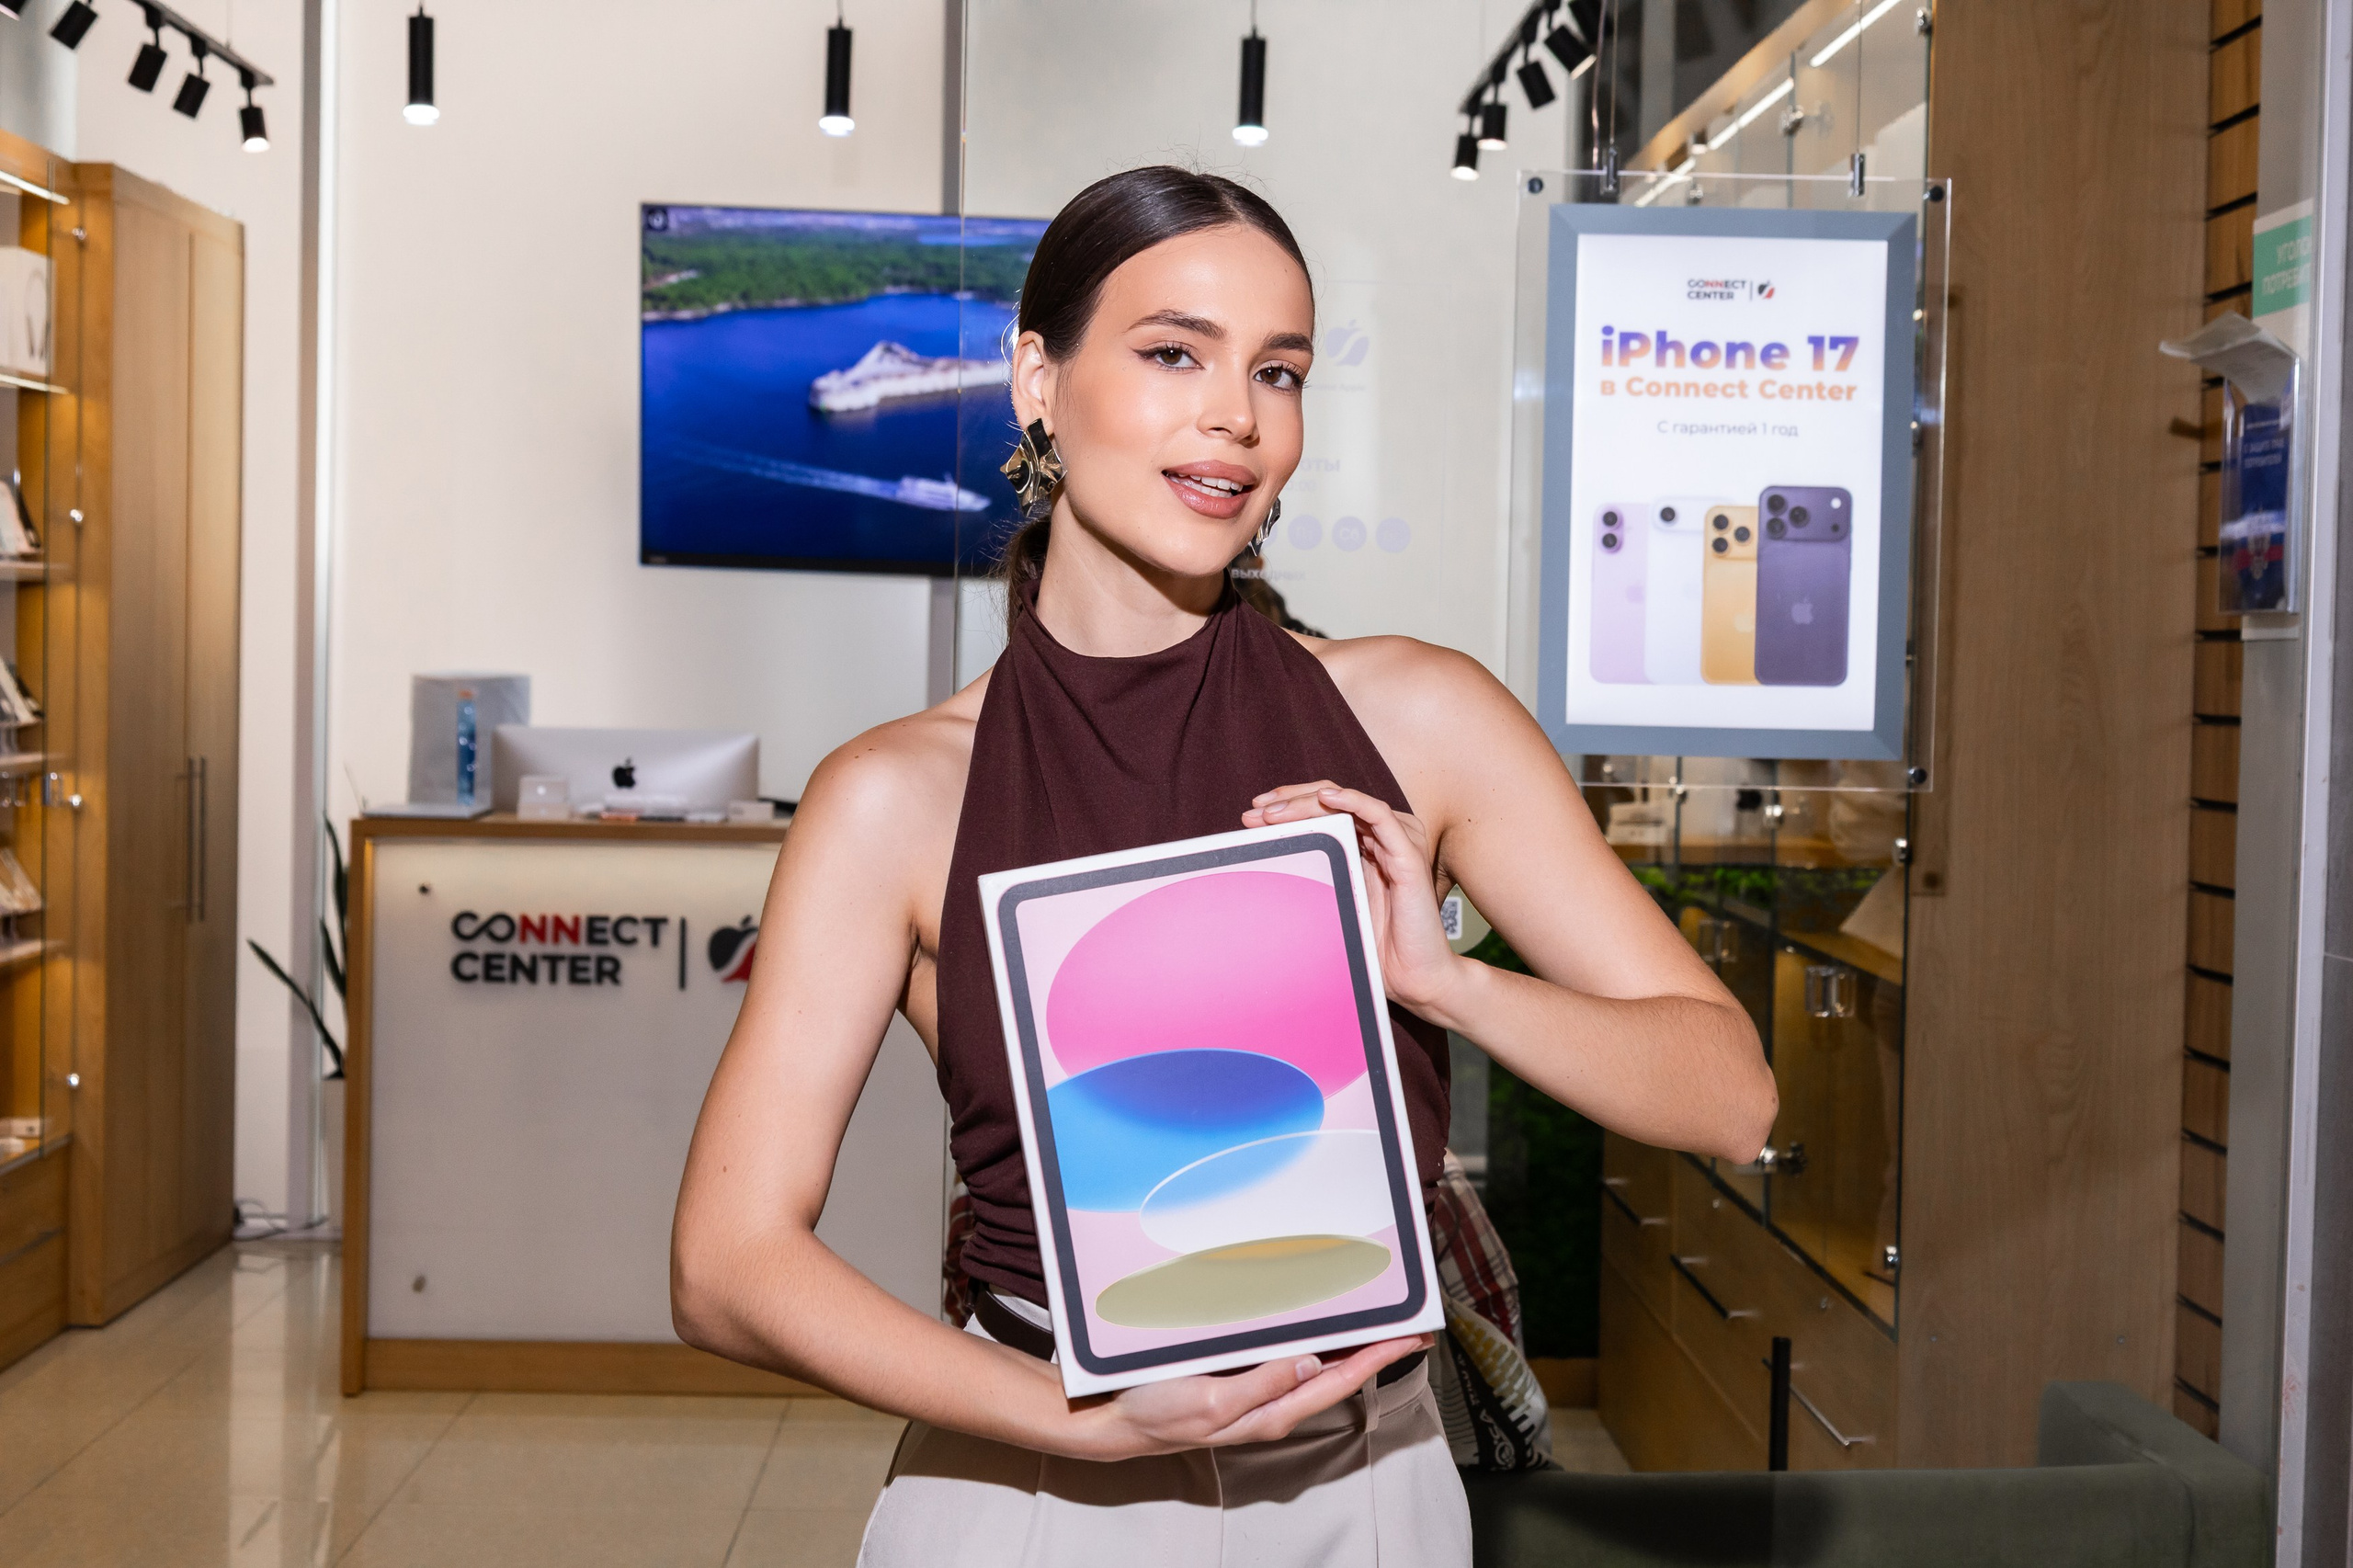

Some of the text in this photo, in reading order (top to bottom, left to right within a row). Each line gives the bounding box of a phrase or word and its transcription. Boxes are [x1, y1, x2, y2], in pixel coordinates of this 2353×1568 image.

[1688, 279, 1746, 290] CONNECT
[1688, 290, 1734, 300] CENTER
[1601, 325, 1859, 372] iPhone 17
[1625, 376, 1748, 399] Connect
[1758, 379, 1858, 401] Center
[1656, 420, 1799, 437] С гарантией 1 год
[451, 912, 668, 948] CONNECT
[451, 952, 621, 986] CENTER
